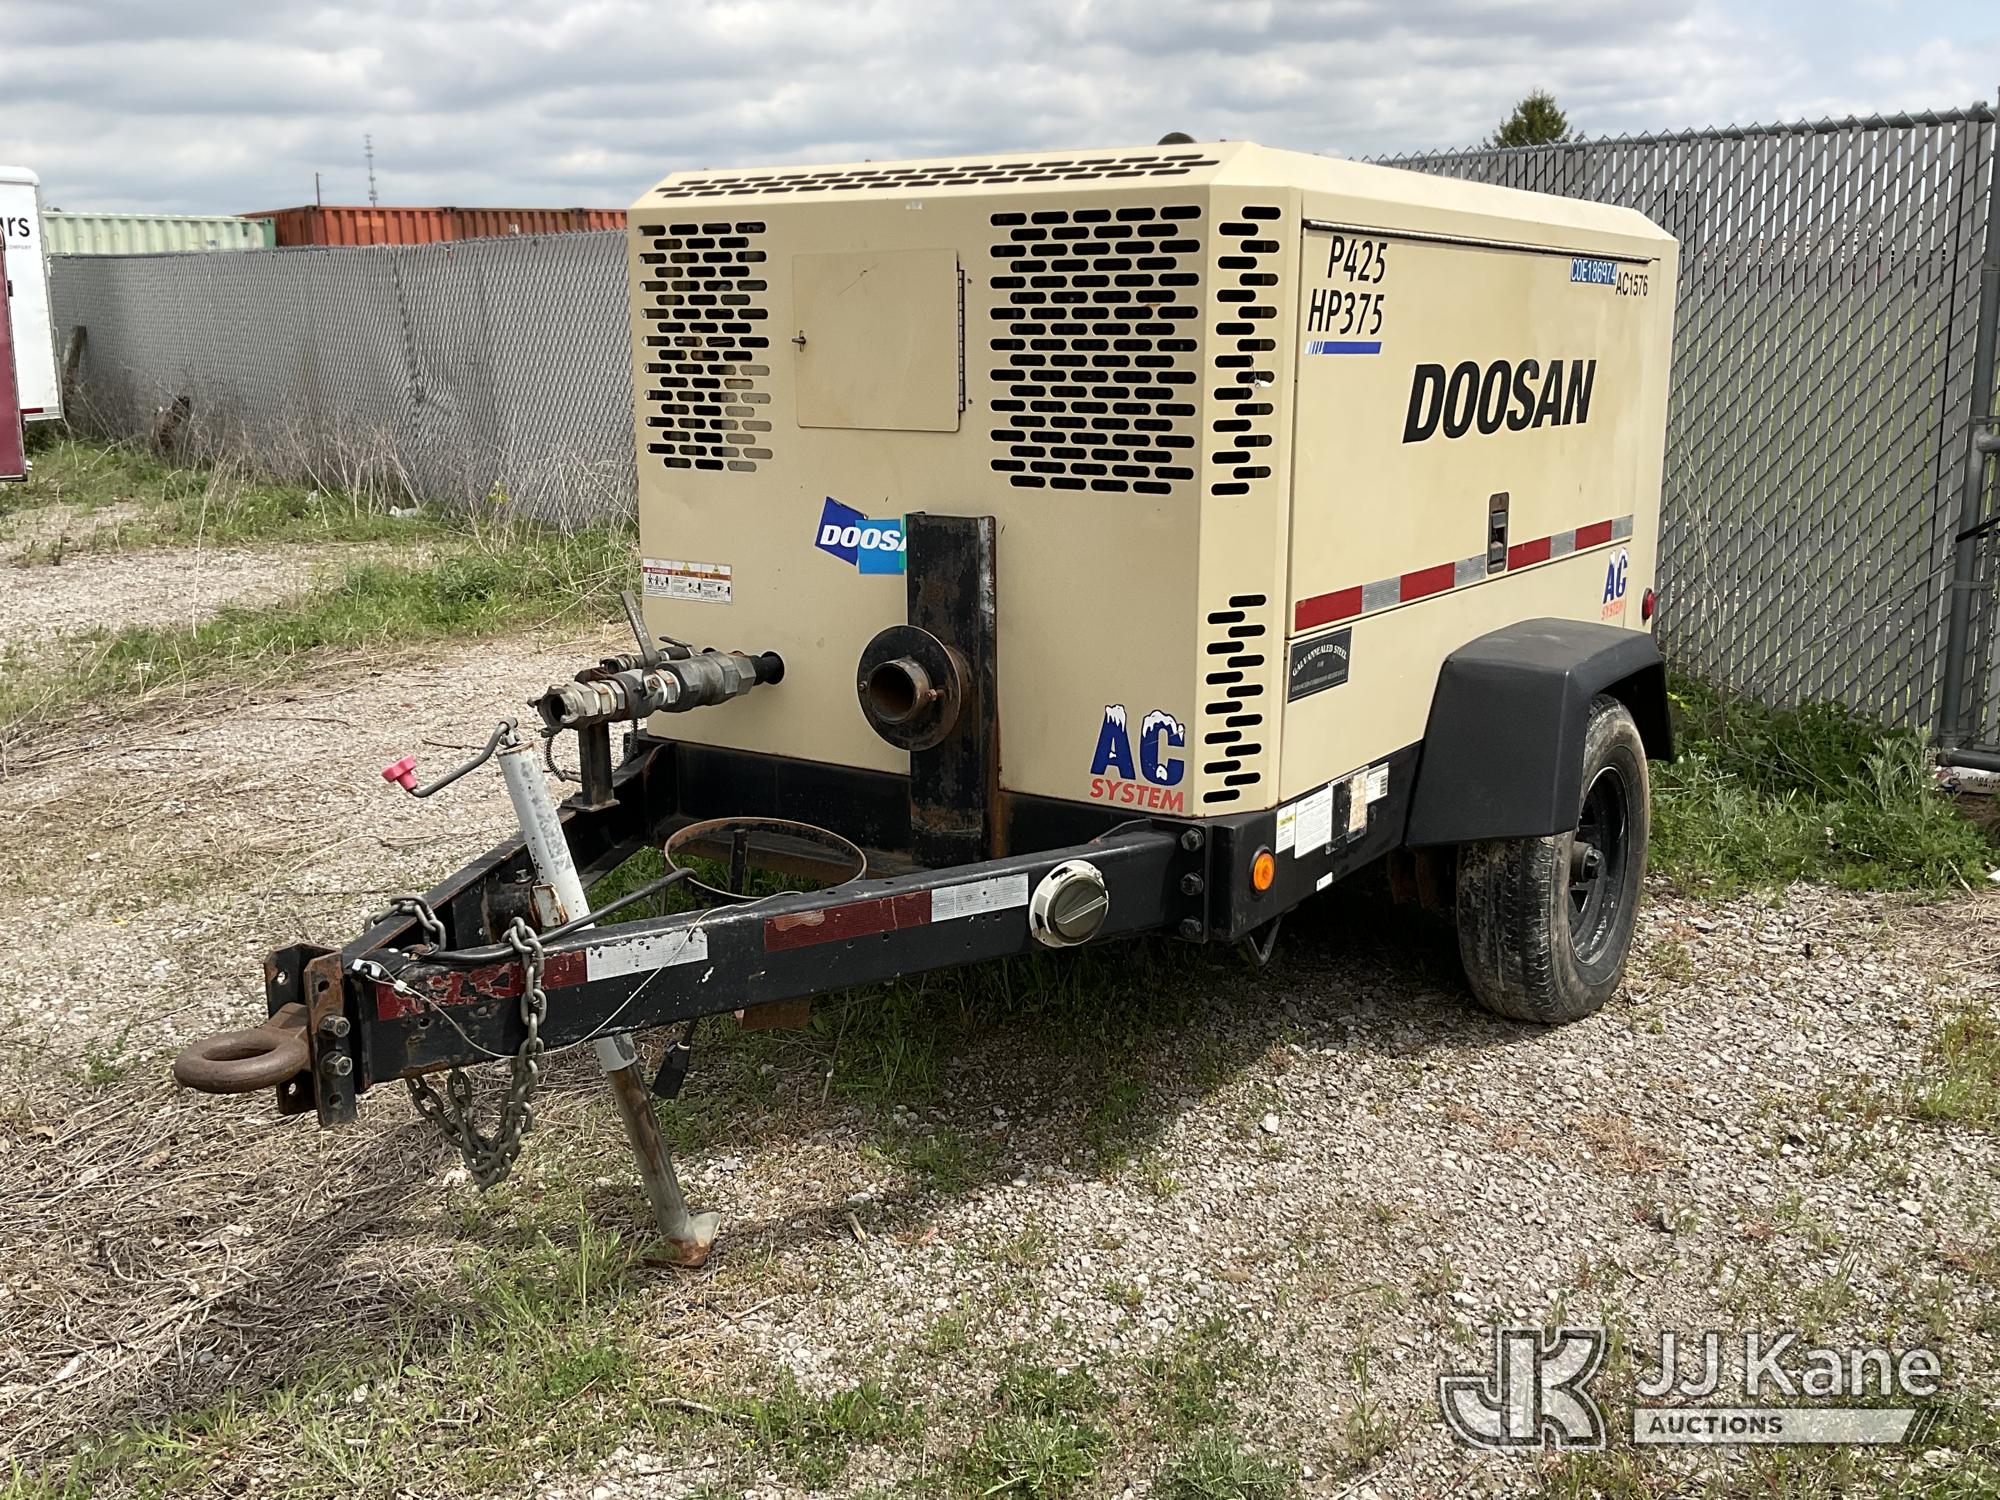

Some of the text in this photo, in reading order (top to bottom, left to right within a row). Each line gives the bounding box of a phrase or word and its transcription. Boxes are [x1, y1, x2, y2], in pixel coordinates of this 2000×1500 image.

[1327, 235, 1388, 284] P425
[1616, 271, 1648, 296] AC1576
[1307, 288, 1385, 335] HP375
[1402, 359, 1597, 444] DOOSAN
[1603, 548, 1628, 604] AC
[1090, 704, 1186, 786] AC
[1090, 778, 1184, 813] SYSTEM
